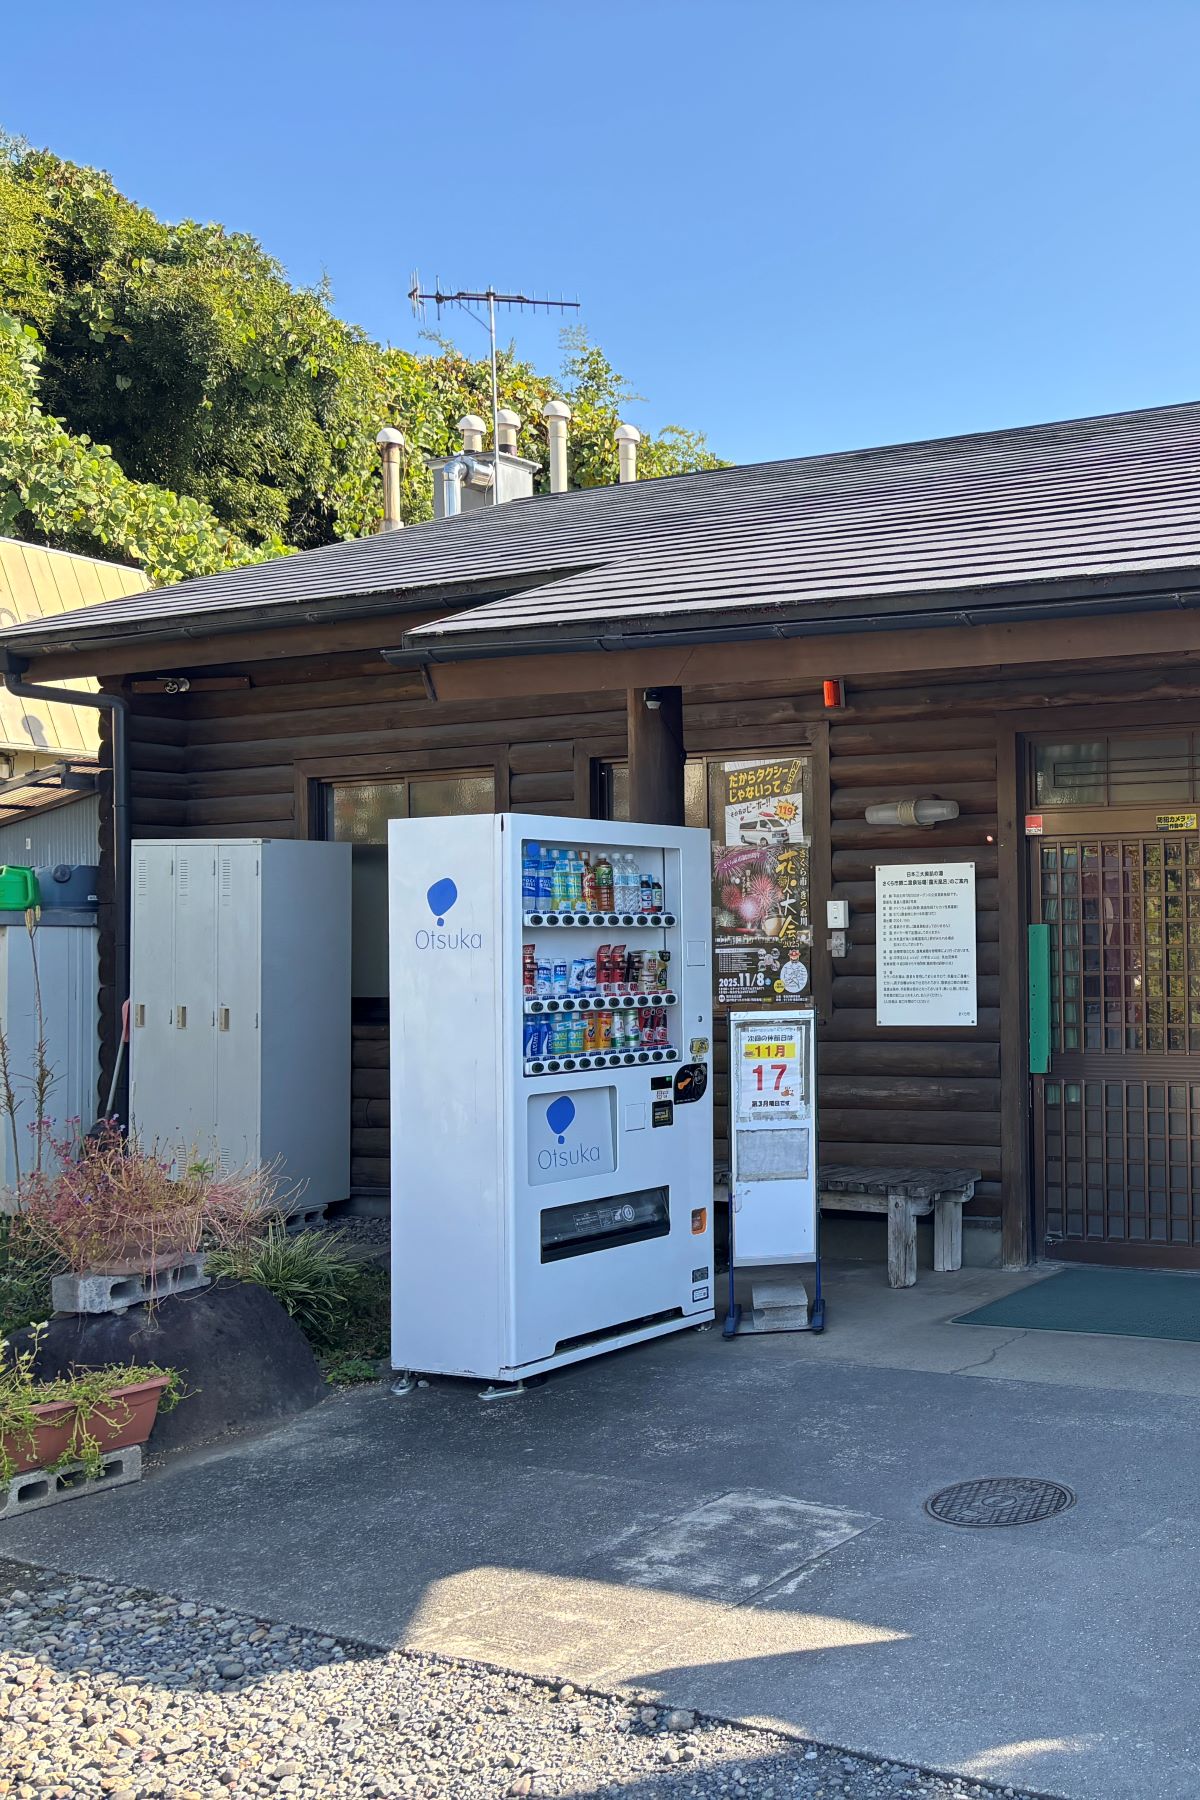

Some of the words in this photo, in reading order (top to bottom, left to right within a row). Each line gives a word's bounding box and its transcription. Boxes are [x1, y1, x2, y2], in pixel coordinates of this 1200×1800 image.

[729, 766, 788, 788] だからタクシー
[729, 781, 780, 803] じゃないって
[778, 805, 793, 816] 119
[415, 928, 482, 949] Otsuka
[754, 1045, 785, 1058] 11月
[752, 1063, 787, 1091] 17
[751, 1100, 791, 1108] 第3月曜日です
[537, 1143, 600, 1170] Otsuka
